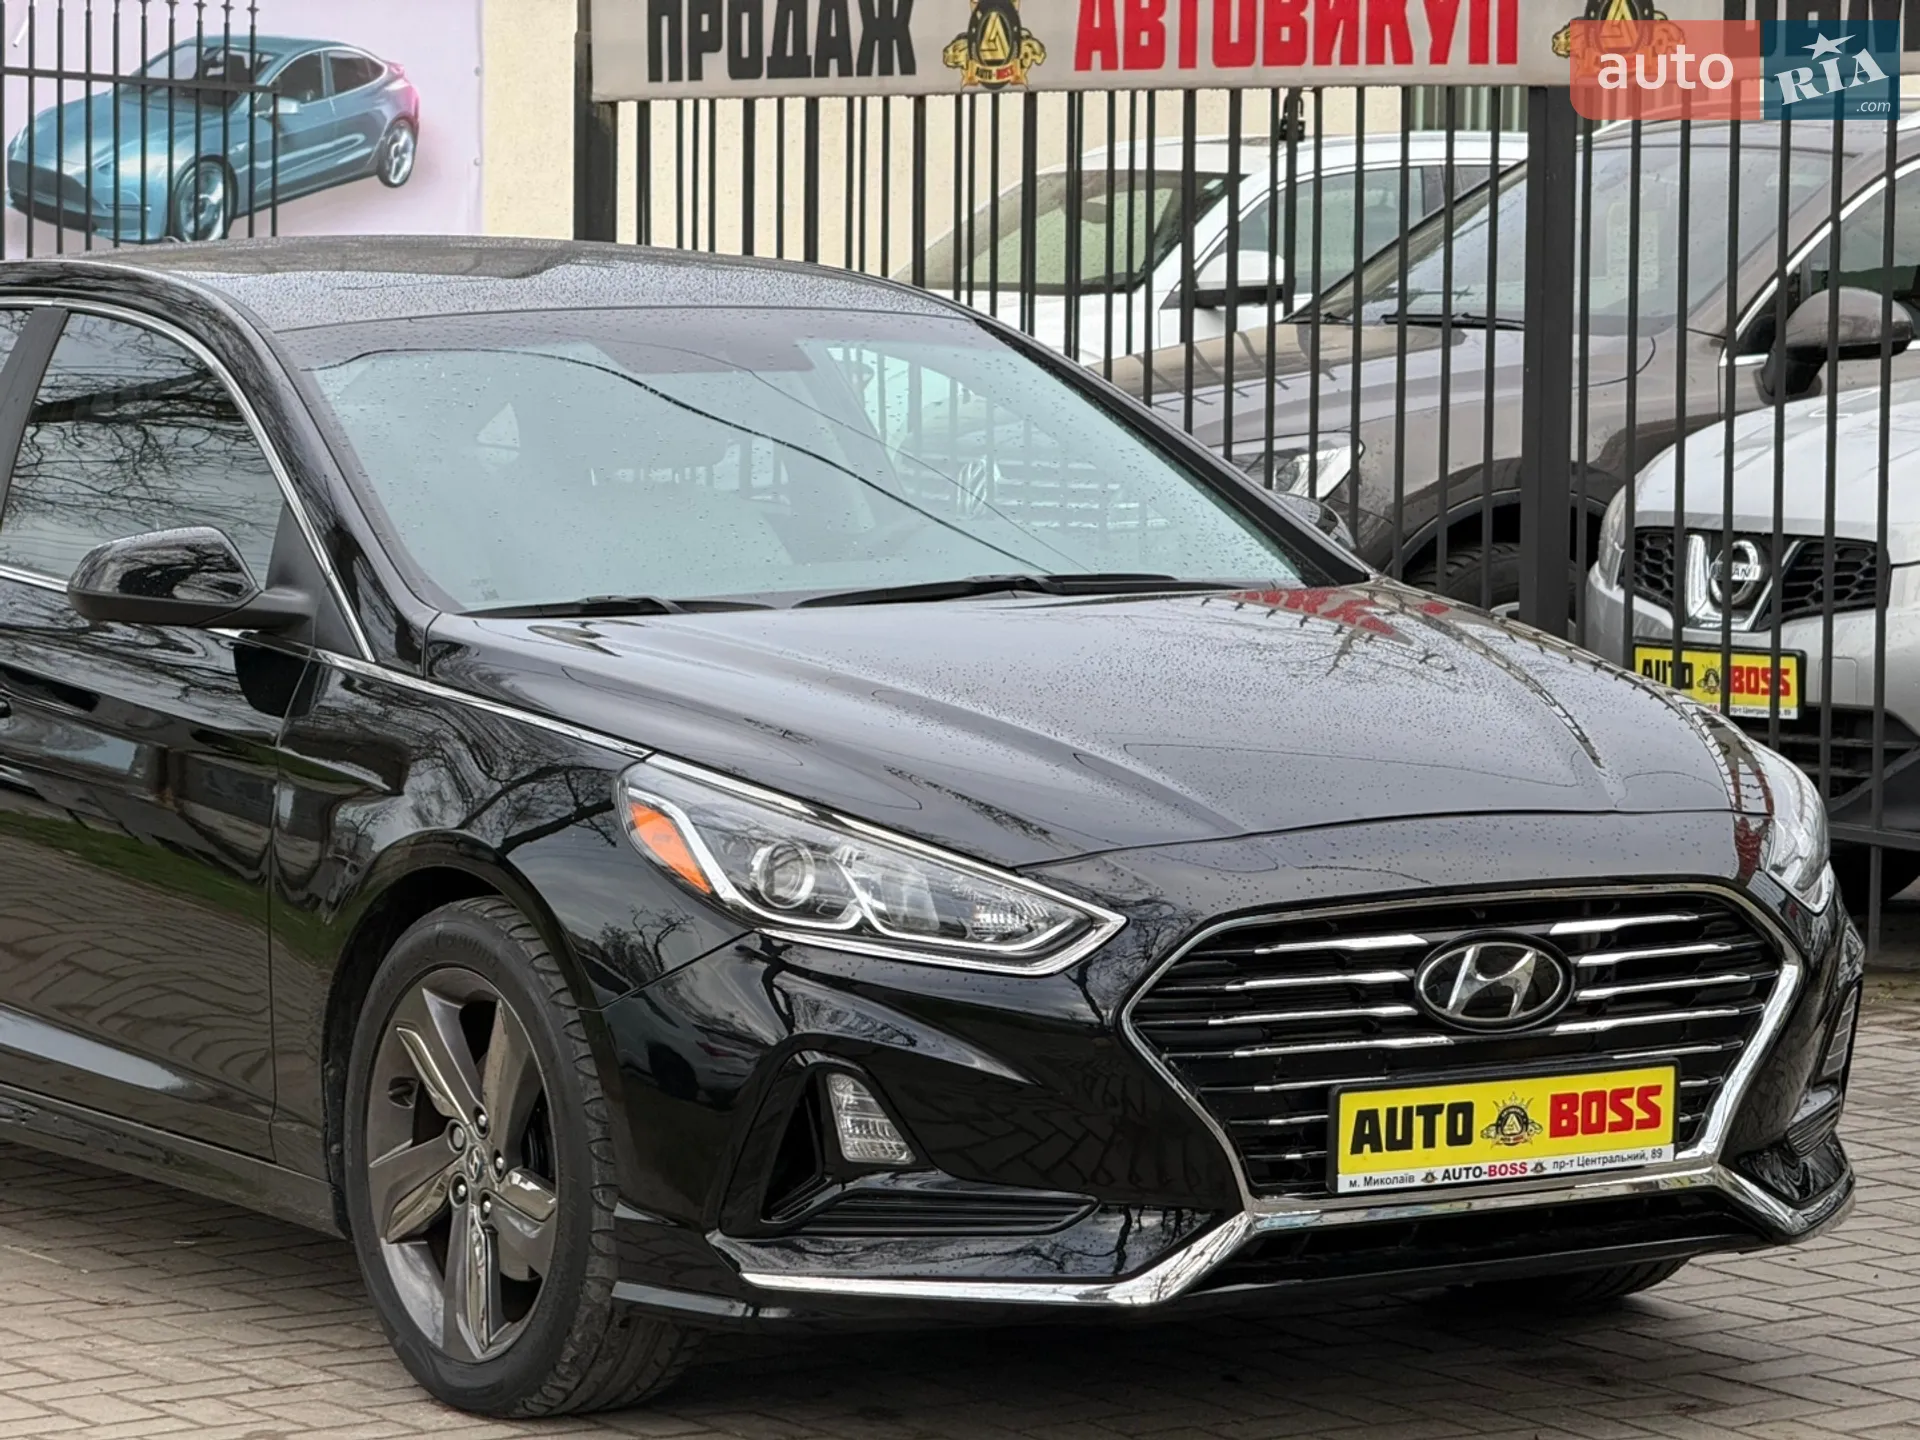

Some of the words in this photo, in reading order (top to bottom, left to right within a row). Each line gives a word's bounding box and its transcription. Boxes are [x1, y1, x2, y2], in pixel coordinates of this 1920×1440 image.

[648, 0, 917, 83] ПРОДАЖ
[1074, 0, 1518, 71] АВТОВИКУП
[1730, 666, 1791, 696] BOSS
[1350, 1101, 1475, 1155] AUTO
[1549, 1084, 1663, 1139] BOSS
[1349, 1179, 1360, 1188] м.
[1363, 1173, 1416, 1187] Миколаїв
[1441, 1162, 1528, 1182] AUTO-BOSS
[1552, 1158, 1575, 1171] пр-т
[1577, 1150, 1648, 1167] Центральний,
[1651, 1148, 1663, 1159] 89
